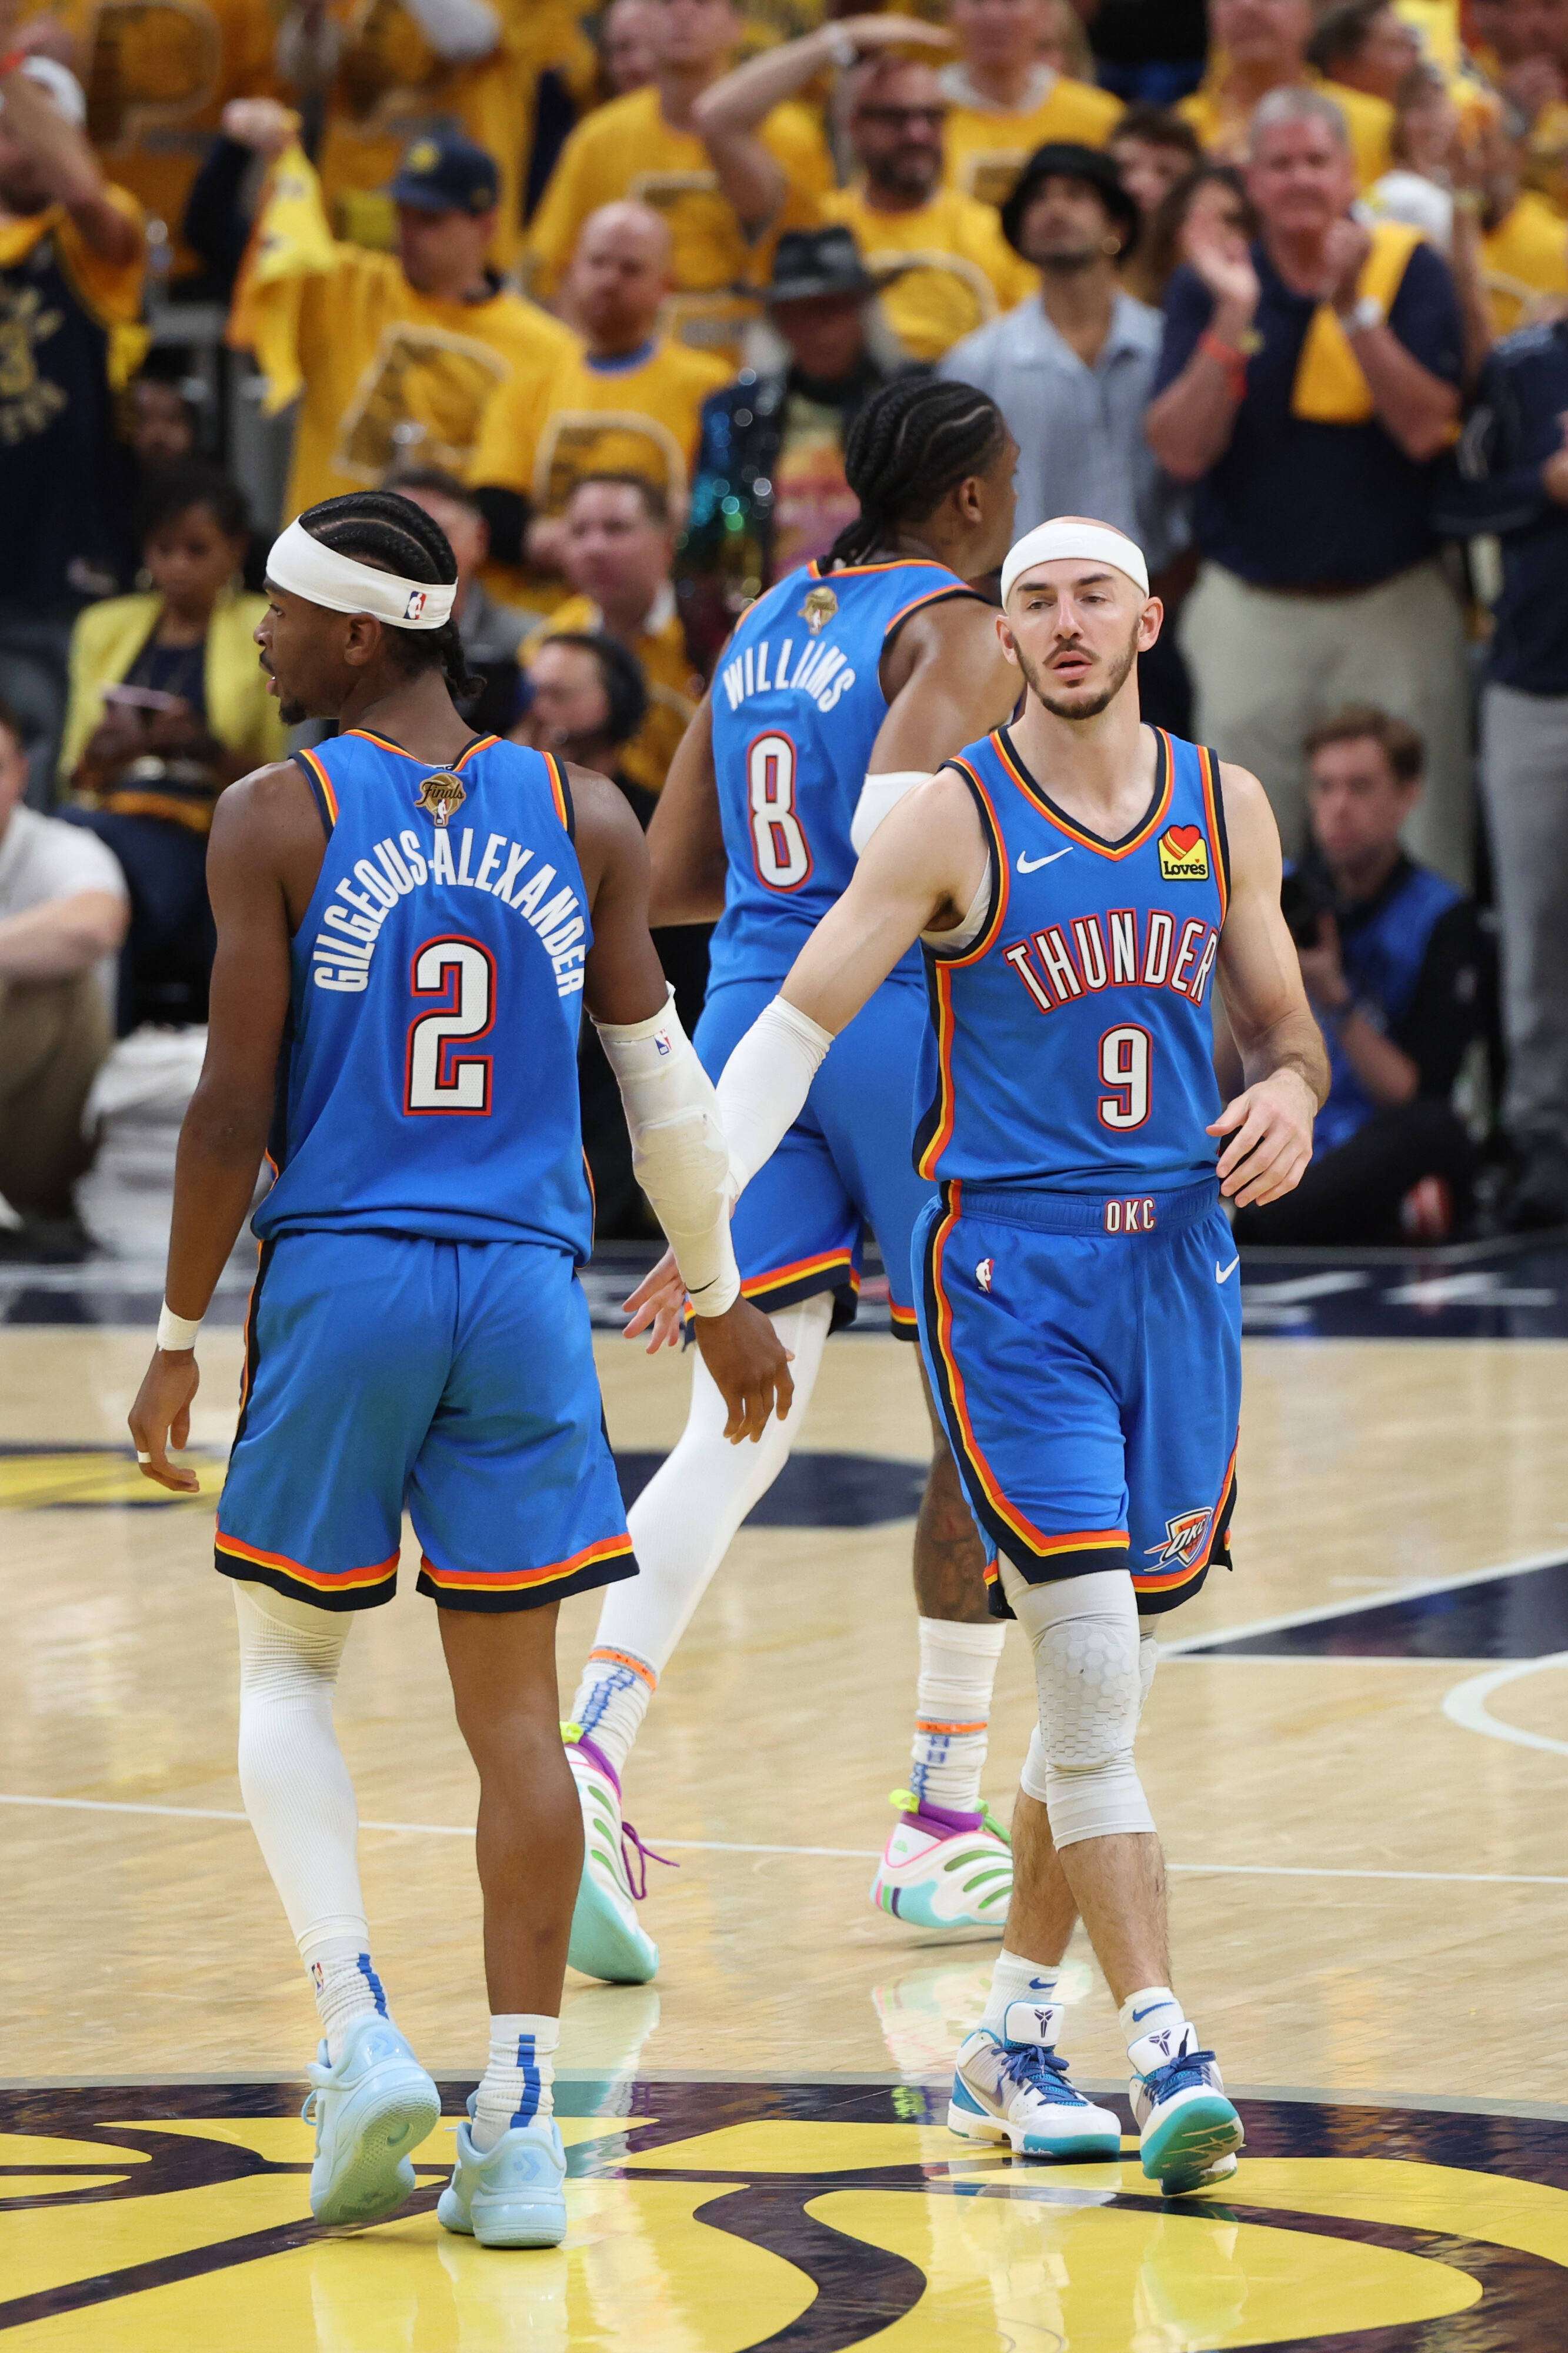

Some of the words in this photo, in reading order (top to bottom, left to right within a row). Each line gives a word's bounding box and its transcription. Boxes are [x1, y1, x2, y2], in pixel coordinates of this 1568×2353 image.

[723, 638, 856, 713] WILLIAMS
[416, 781, 464, 805] Finals
[746, 729, 814, 894] 8
[313, 828, 586, 998] GILGEOUS-ALEXANDER
[1002, 908, 1219, 1014] THUNDER
[403, 934, 497, 1115] 2
[1097, 1022, 1153, 1132] 9
[1104, 1196, 1157, 1234] OKC
